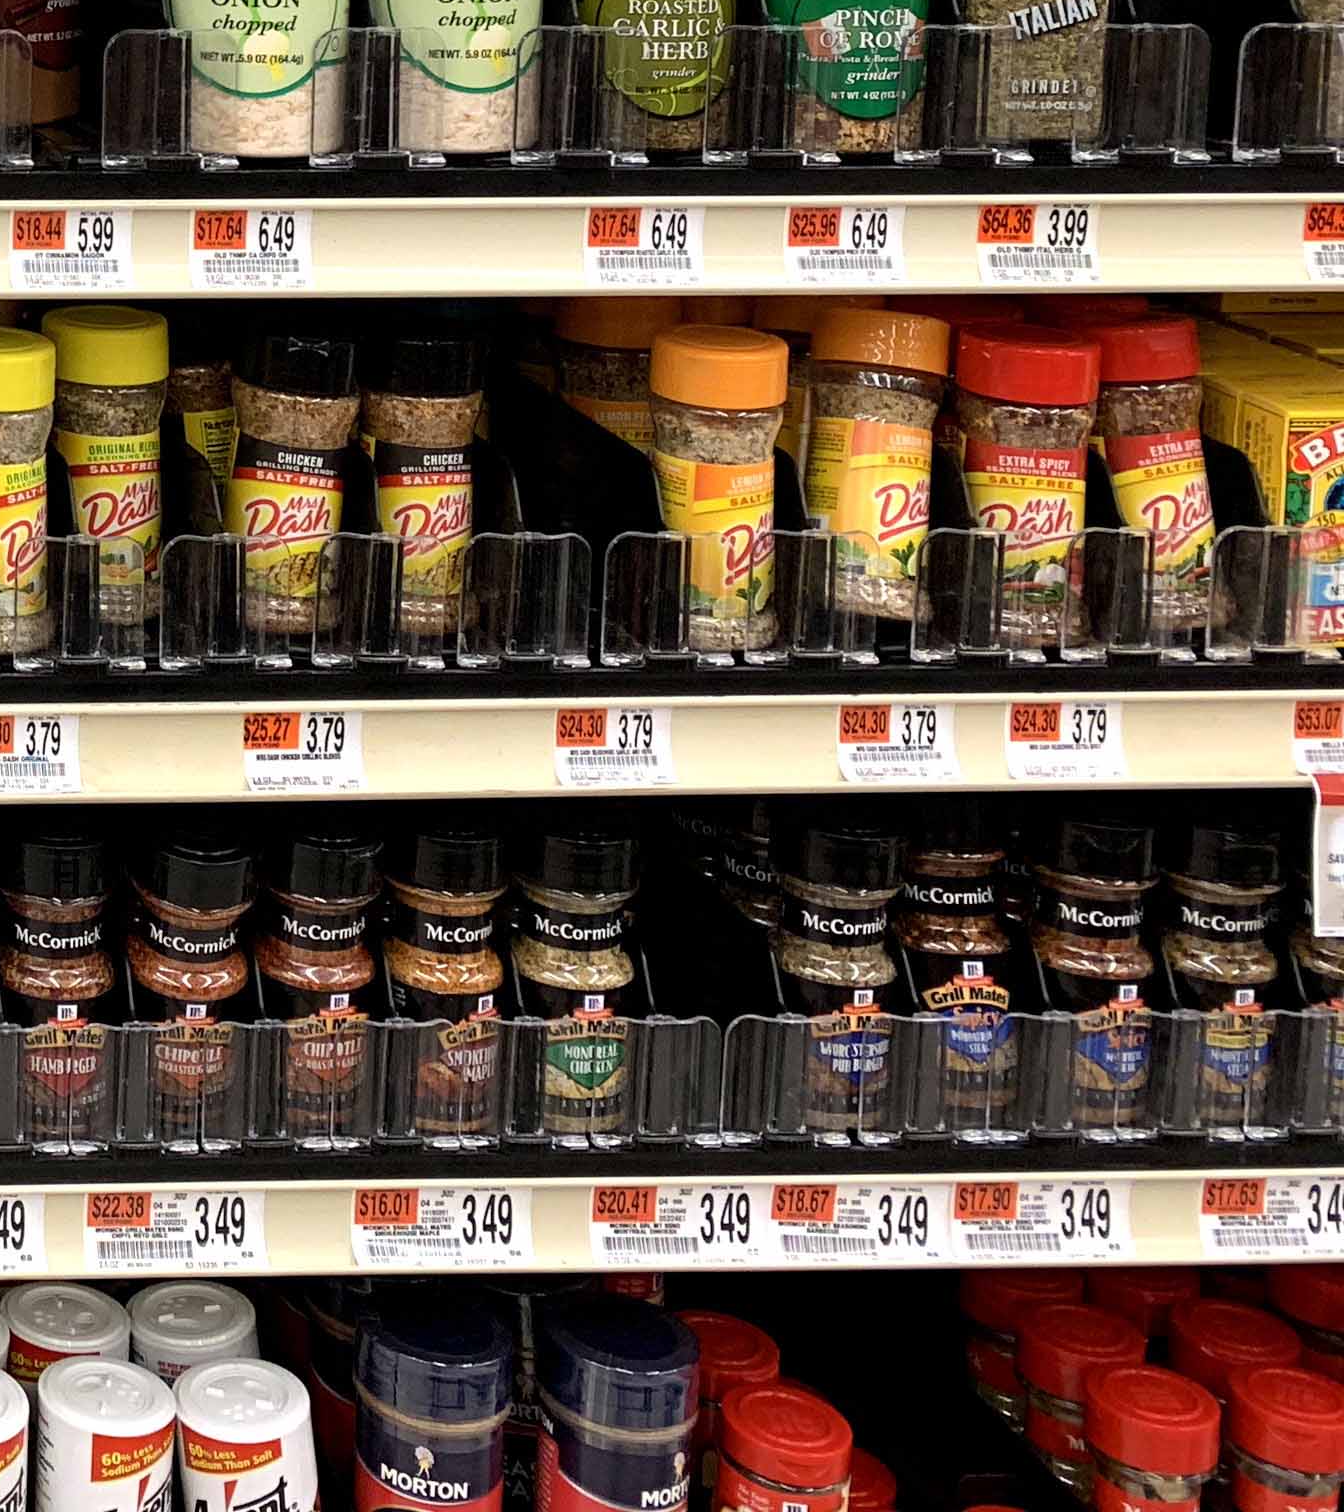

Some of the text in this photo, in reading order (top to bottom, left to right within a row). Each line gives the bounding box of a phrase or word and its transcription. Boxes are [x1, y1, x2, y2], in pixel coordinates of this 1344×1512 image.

[212, 13, 296, 35] chopped
[613, 18, 726, 37] GARLIC &
[835, 9, 909, 26] PINCH
[642, 41, 708, 59] HERB
[197, 216, 295, 252] $17.64 6.49
[982, 210, 1088, 246] $64.36 3.99
[999, 456, 1070, 471] EXTRA SPICY
[26, 722, 60, 756] 3.79
[245, 717, 345, 753] $25.27 3.79
[597, 1191, 751, 1243] $20.41 3.49
[380, 1464, 469, 1500] MORTON
